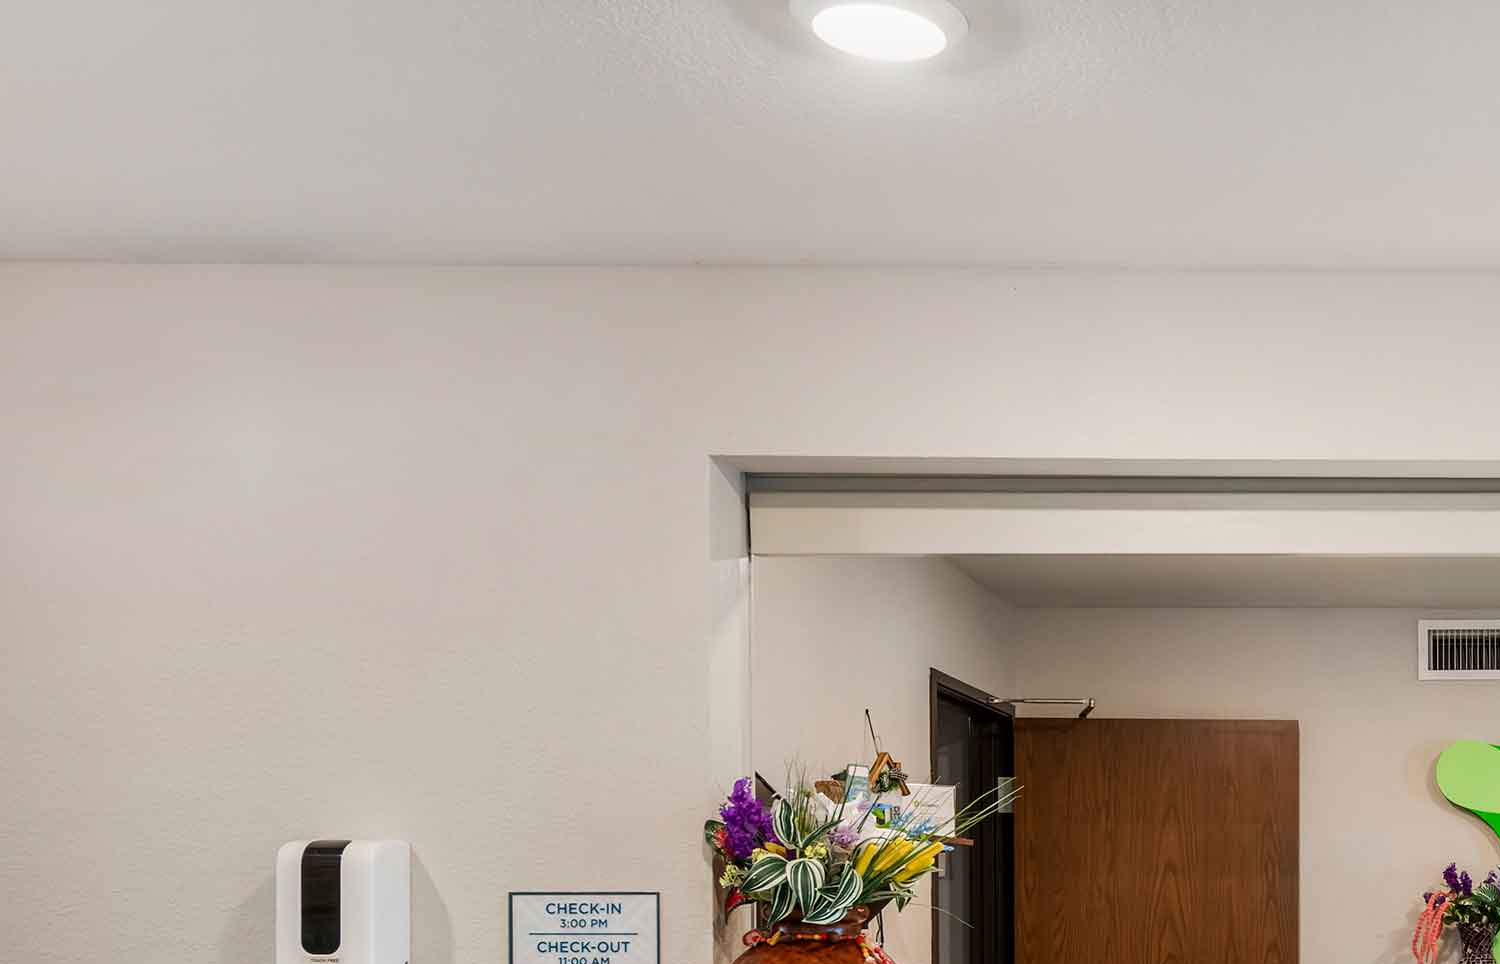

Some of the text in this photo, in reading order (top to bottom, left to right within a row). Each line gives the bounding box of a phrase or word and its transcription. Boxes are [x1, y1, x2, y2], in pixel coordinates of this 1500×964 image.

[545, 902, 622, 915] CHECK-IN
[560, 918, 608, 928] 3:00 PM
[537, 941, 631, 953] CHECK-OUT
